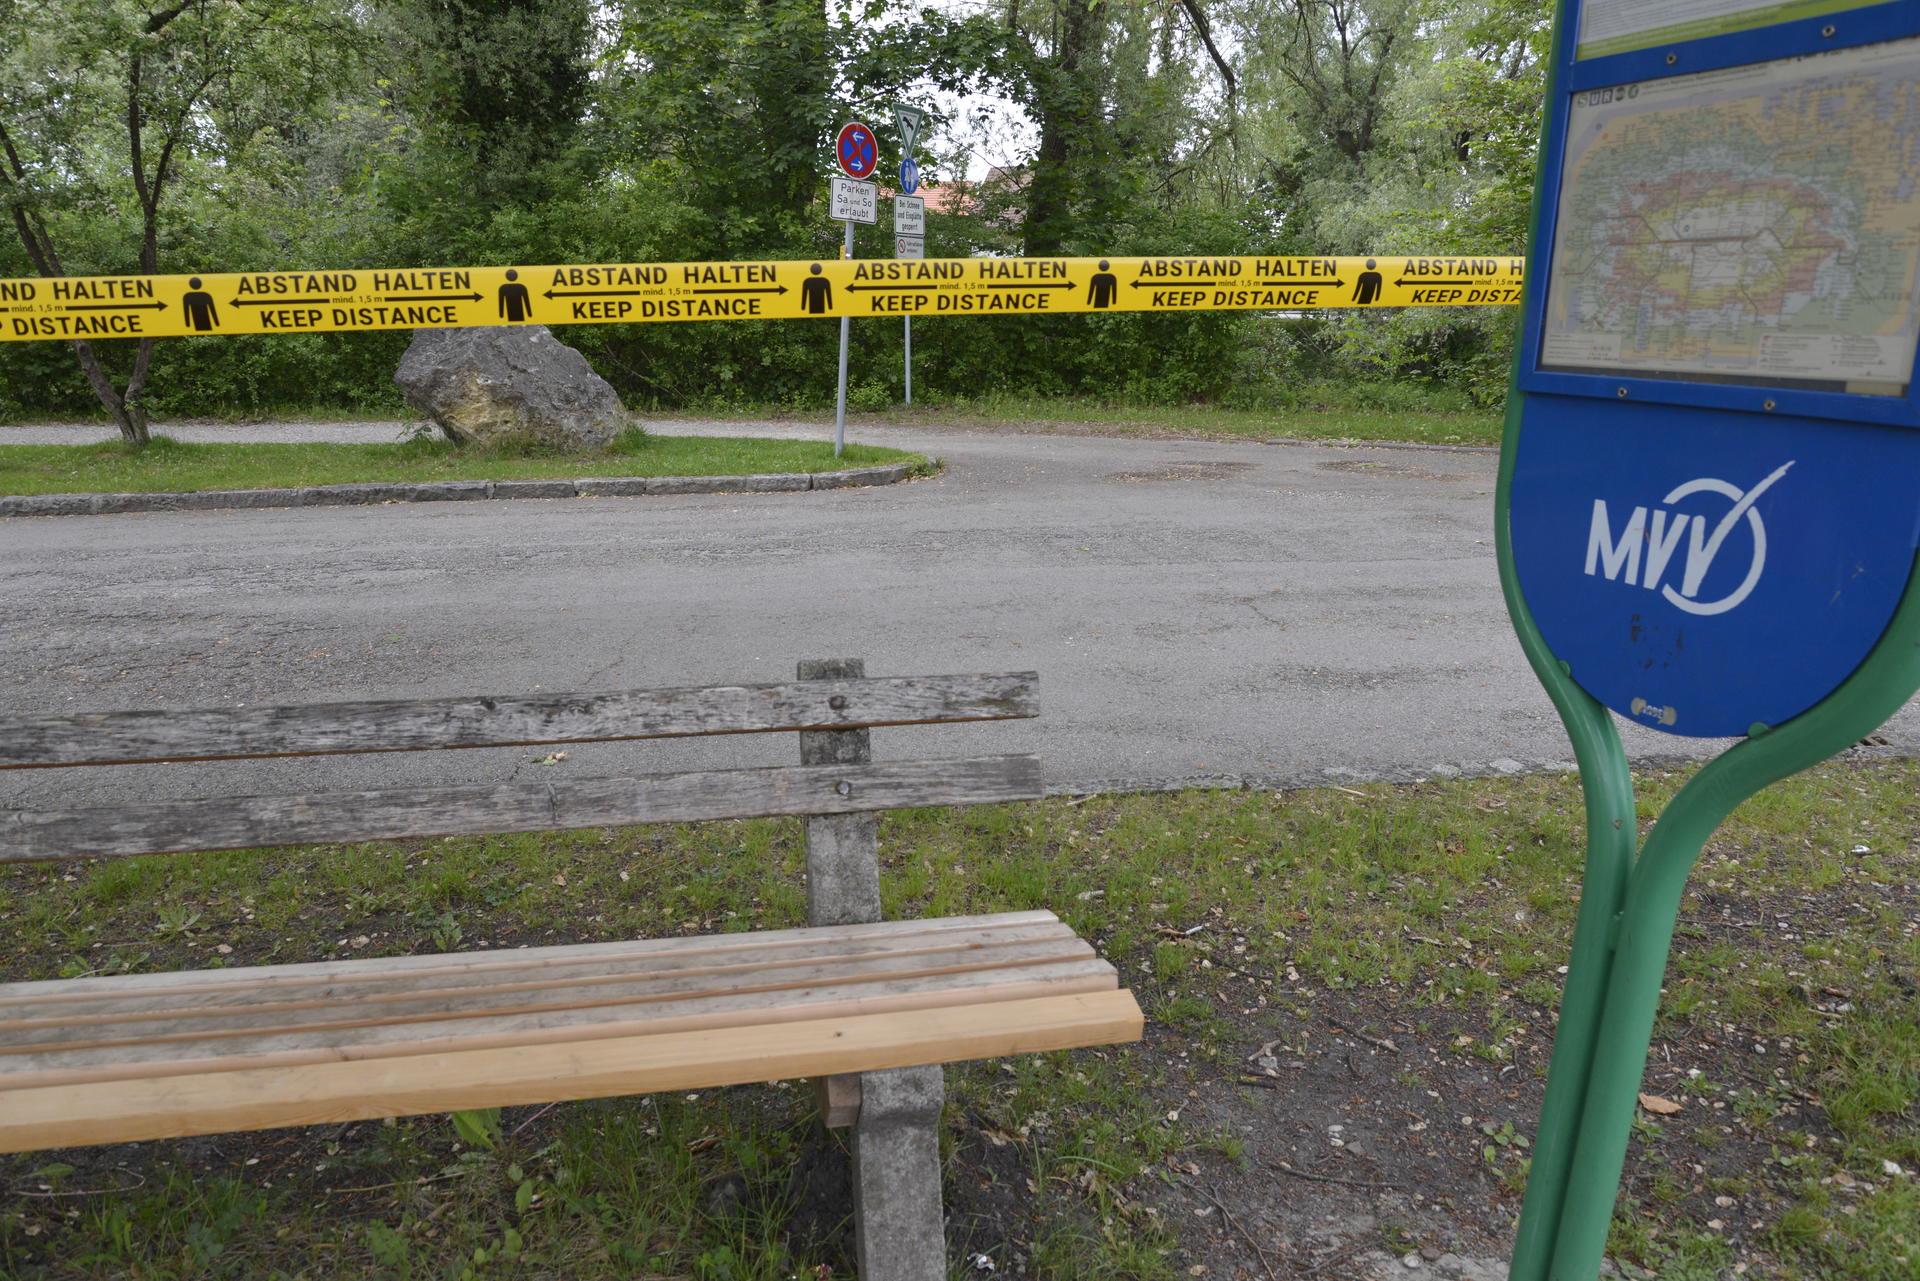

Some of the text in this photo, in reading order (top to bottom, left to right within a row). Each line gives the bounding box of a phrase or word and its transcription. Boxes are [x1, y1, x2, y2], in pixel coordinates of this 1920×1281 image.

[841, 183, 869, 196] Parken
[837, 194, 848, 204] Sa
[862, 198, 872, 207] So
[840, 207, 868, 218] erlaubt
[552, 265, 776, 287] ABSTAND HALTEN
[855, 262, 1067, 281] ABSTAND HALTEN
[1139, 259, 1336, 277] ABSTAND HALTEN
[1403, 259, 1497, 276] ABSTAND
[53, 279, 154, 301] HALTEN
[238, 272, 470, 295] ABSTAND HALTEN
[939, 282, 960, 290] mind.
[962, 282, 974, 290] 1,5
[1218, 279, 1238, 287] mind.
[1240, 279, 1251, 287] 1,5
[1475, 278, 1493, 286] mind.
[1496, 278, 1506, 286] 1,5
[331, 295, 357, 304] mind.
[359, 295, 372, 304] 1,5
[642, 288, 665, 296] mind.
[667, 287, 680, 296] 1,5
[1153, 289, 1319, 307] KEEP DISTANCE
[1411, 289, 1462, 303] KEEP
[11, 304, 36, 312] mind.
[38, 304, 53, 313] 1,5
[573, 297, 760, 320] KEEP DISTANCE
[872, 293, 1049, 312] KEEP DISTANCE
[260, 305, 458, 329] KEEP DISTANCE
[12, 315, 143, 337] DISTANCE
[1584, 461, 1795, 598] MVV
